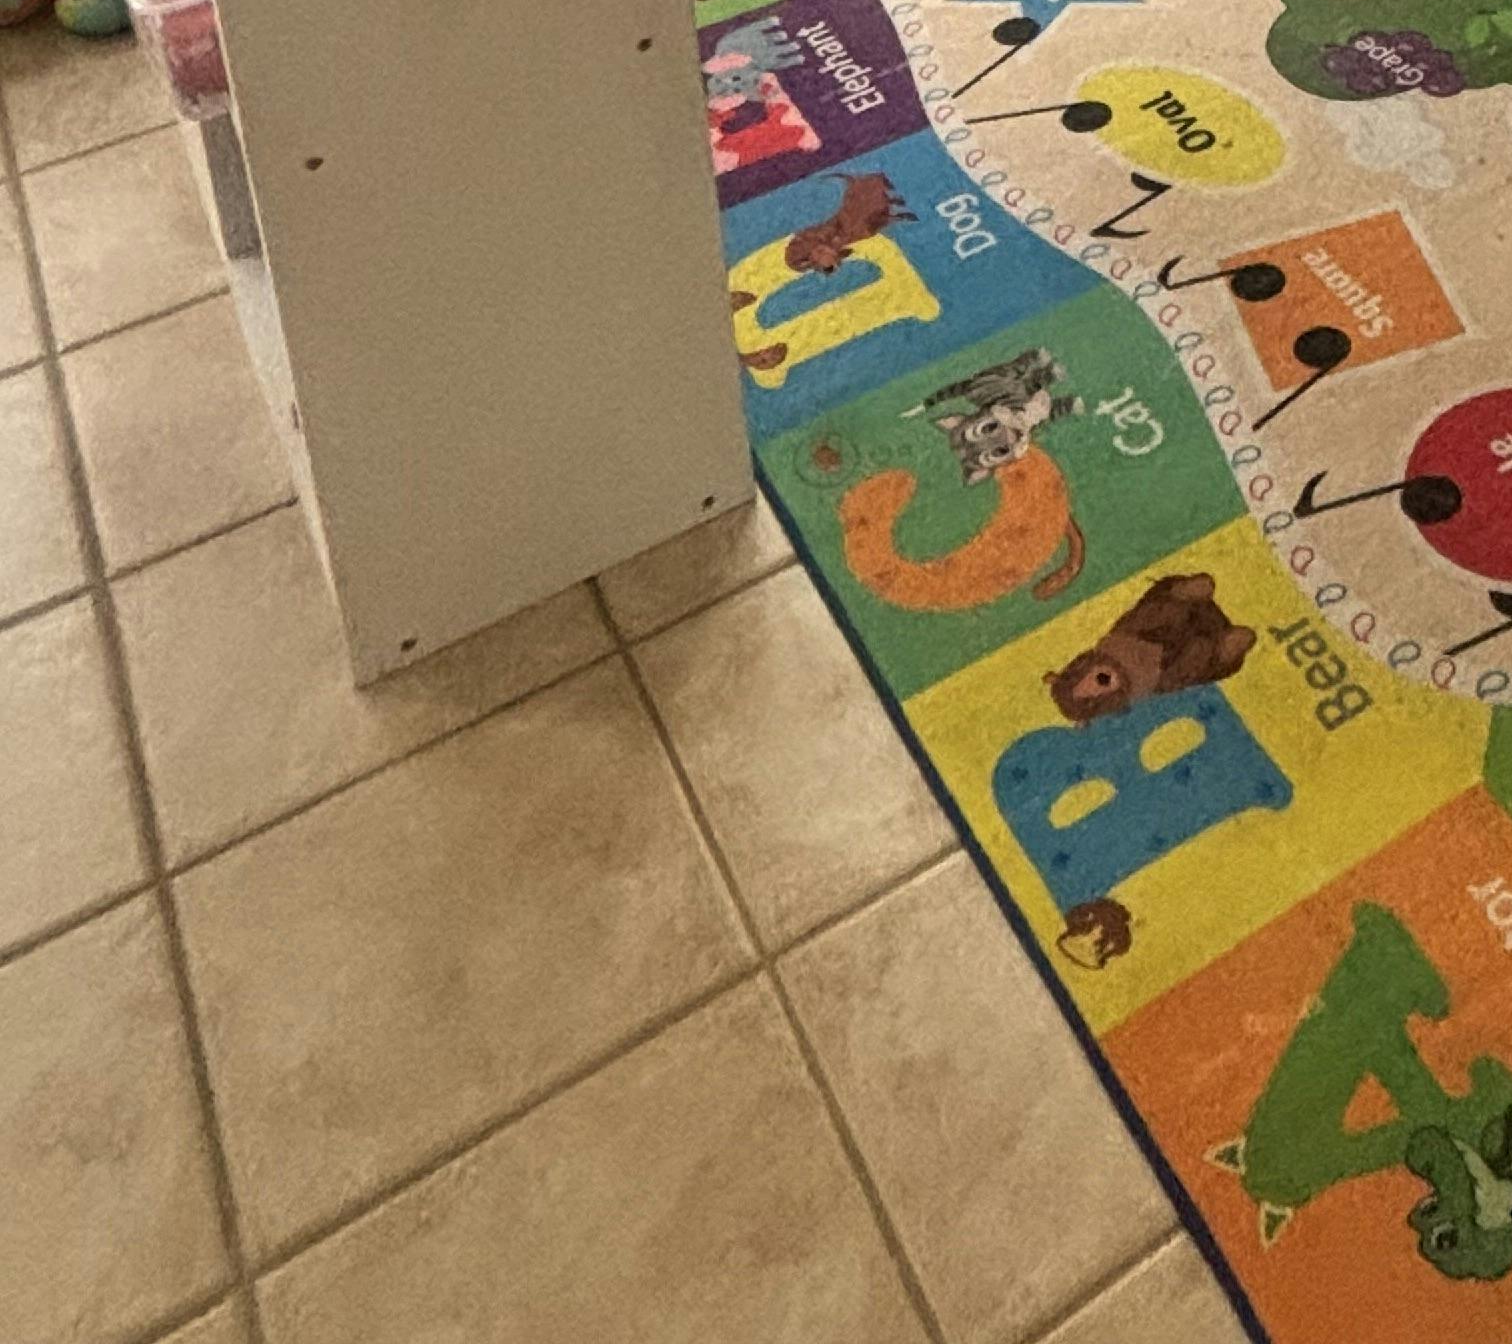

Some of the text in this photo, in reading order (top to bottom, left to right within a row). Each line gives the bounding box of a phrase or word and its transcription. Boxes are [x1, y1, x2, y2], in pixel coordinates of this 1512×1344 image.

[796, 20, 886, 115] Elephant
[1352, 35, 1425, 87] Grape
[1139, 90, 1218, 154] Oval
[935, 191, 997, 261] Dog
[1300, 245, 1397, 340] Square
[1094, 386, 1165, 456] Cat
[1266, 617, 1375, 732] Bear
[991, 683, 1295, 916] B
